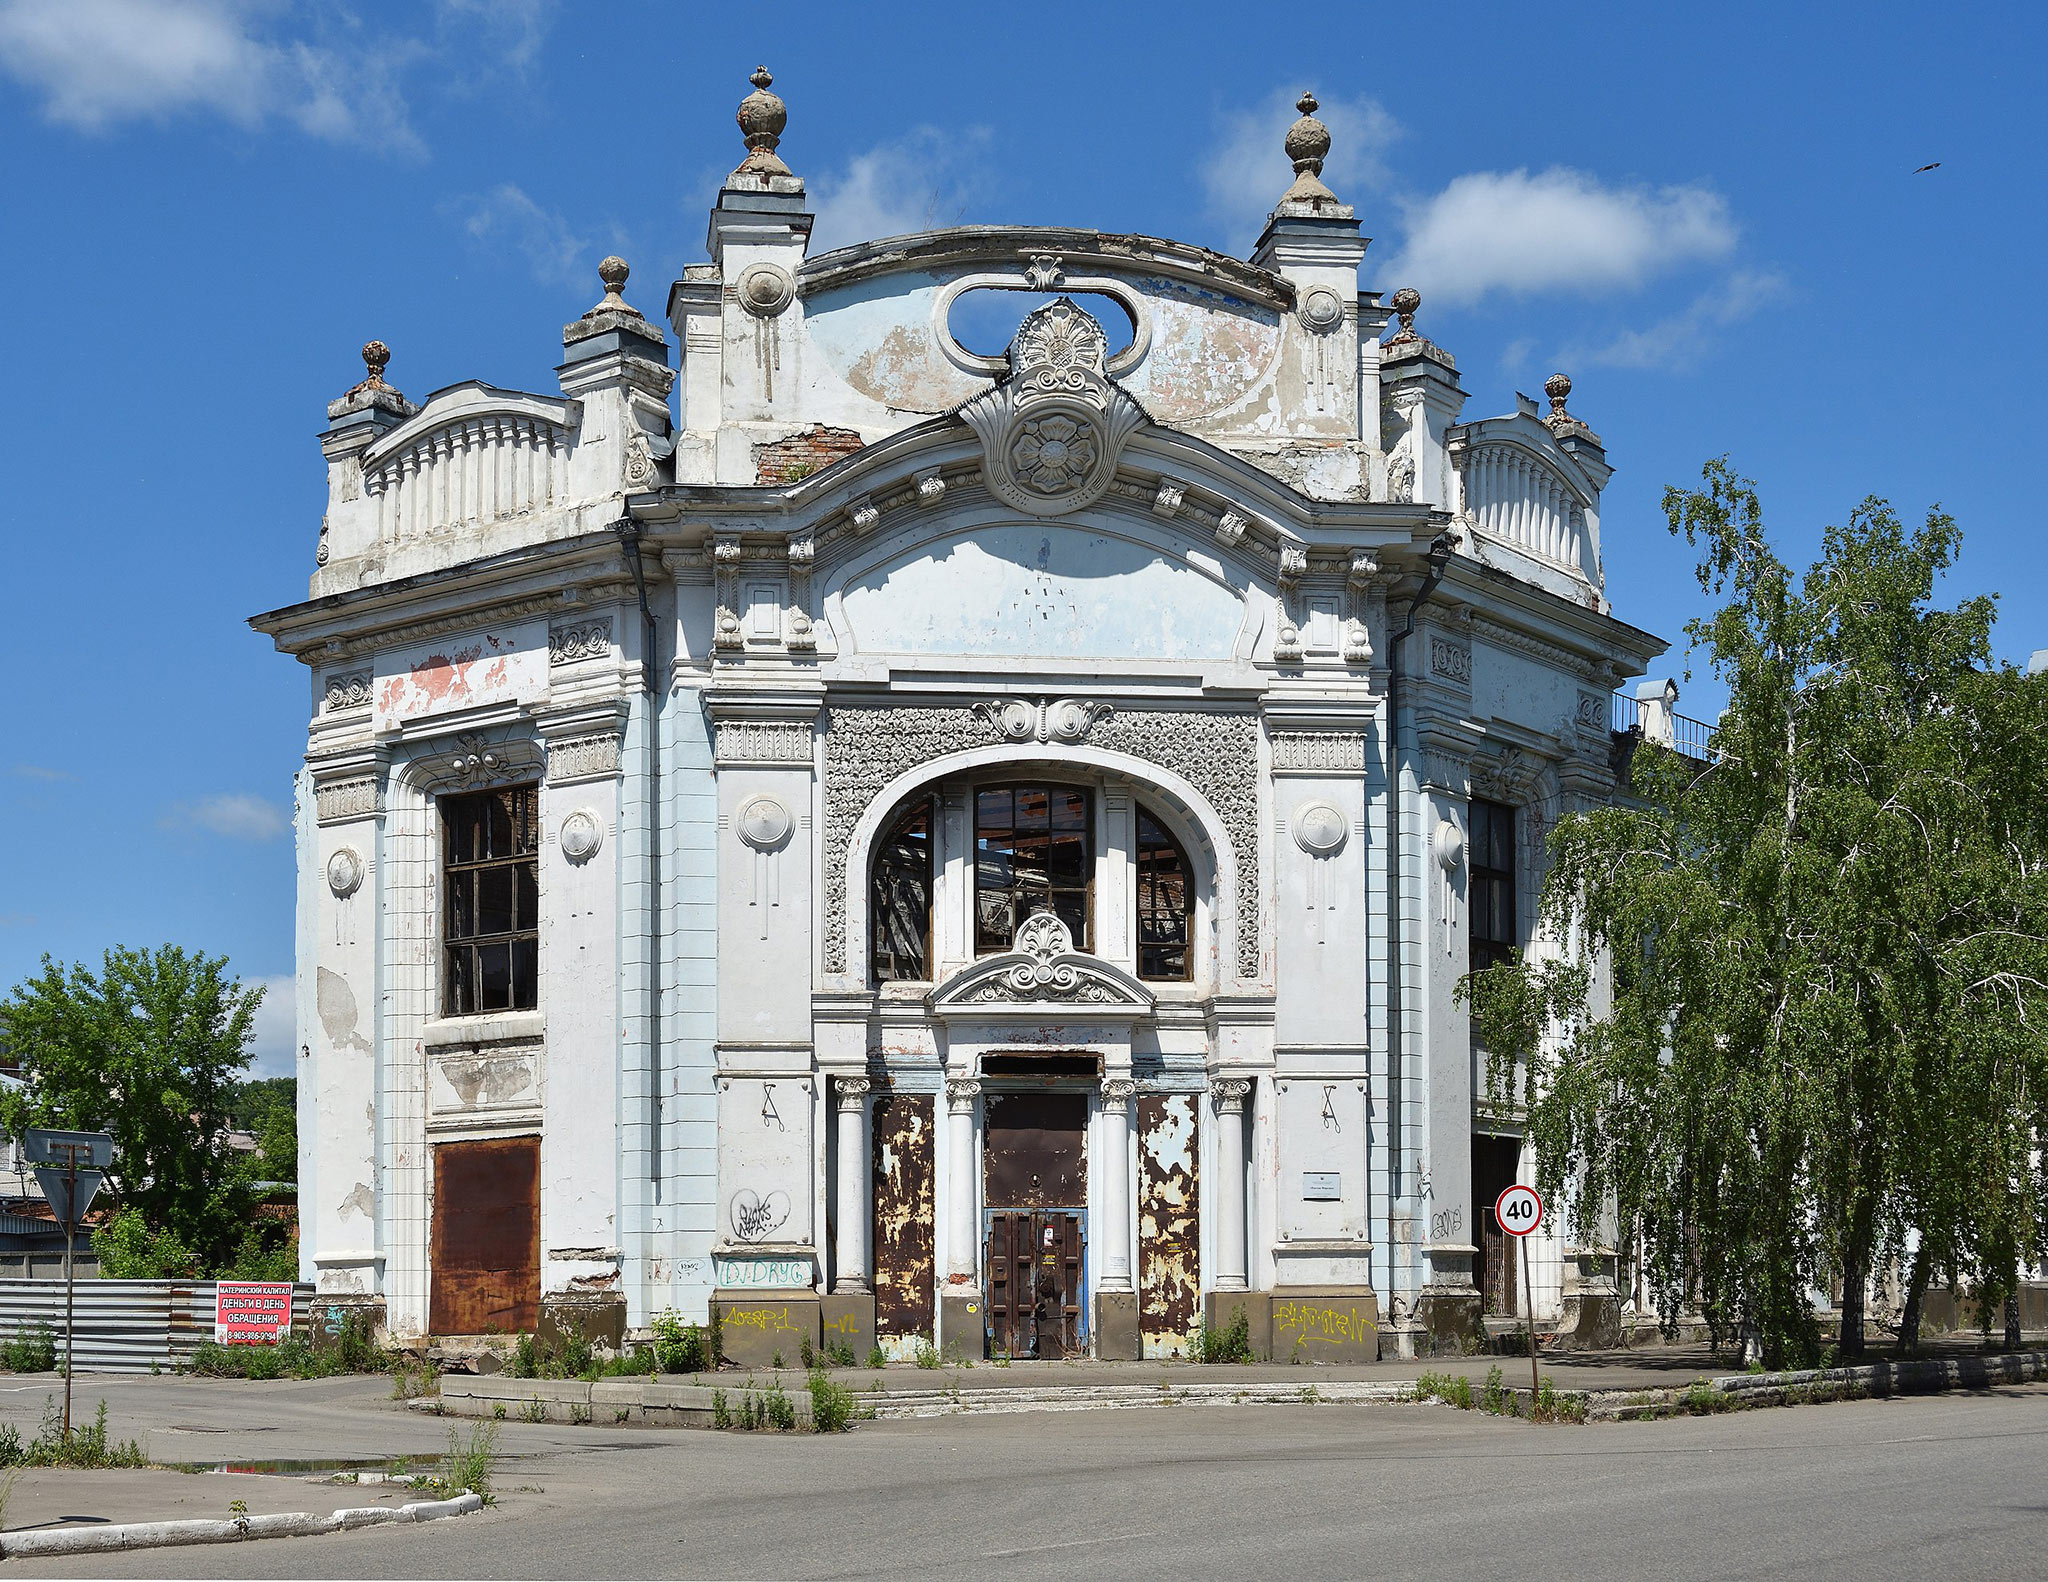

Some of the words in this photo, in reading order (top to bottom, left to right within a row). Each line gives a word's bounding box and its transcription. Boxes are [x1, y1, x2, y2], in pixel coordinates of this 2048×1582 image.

[1506, 1200, 1533, 1220] 40
[219, 1285, 262, 1295] МАТЕРИНСКИЙ
[263, 1287, 290, 1295] КАПИТАЛ
[221, 1298, 254, 1310] ДЕНЬГИ
[255, 1299, 262, 1309] В
[263, 1299, 286, 1310] ДЕНЬ
[227, 1313, 279, 1325] ОБРАЩЕНИЯ
